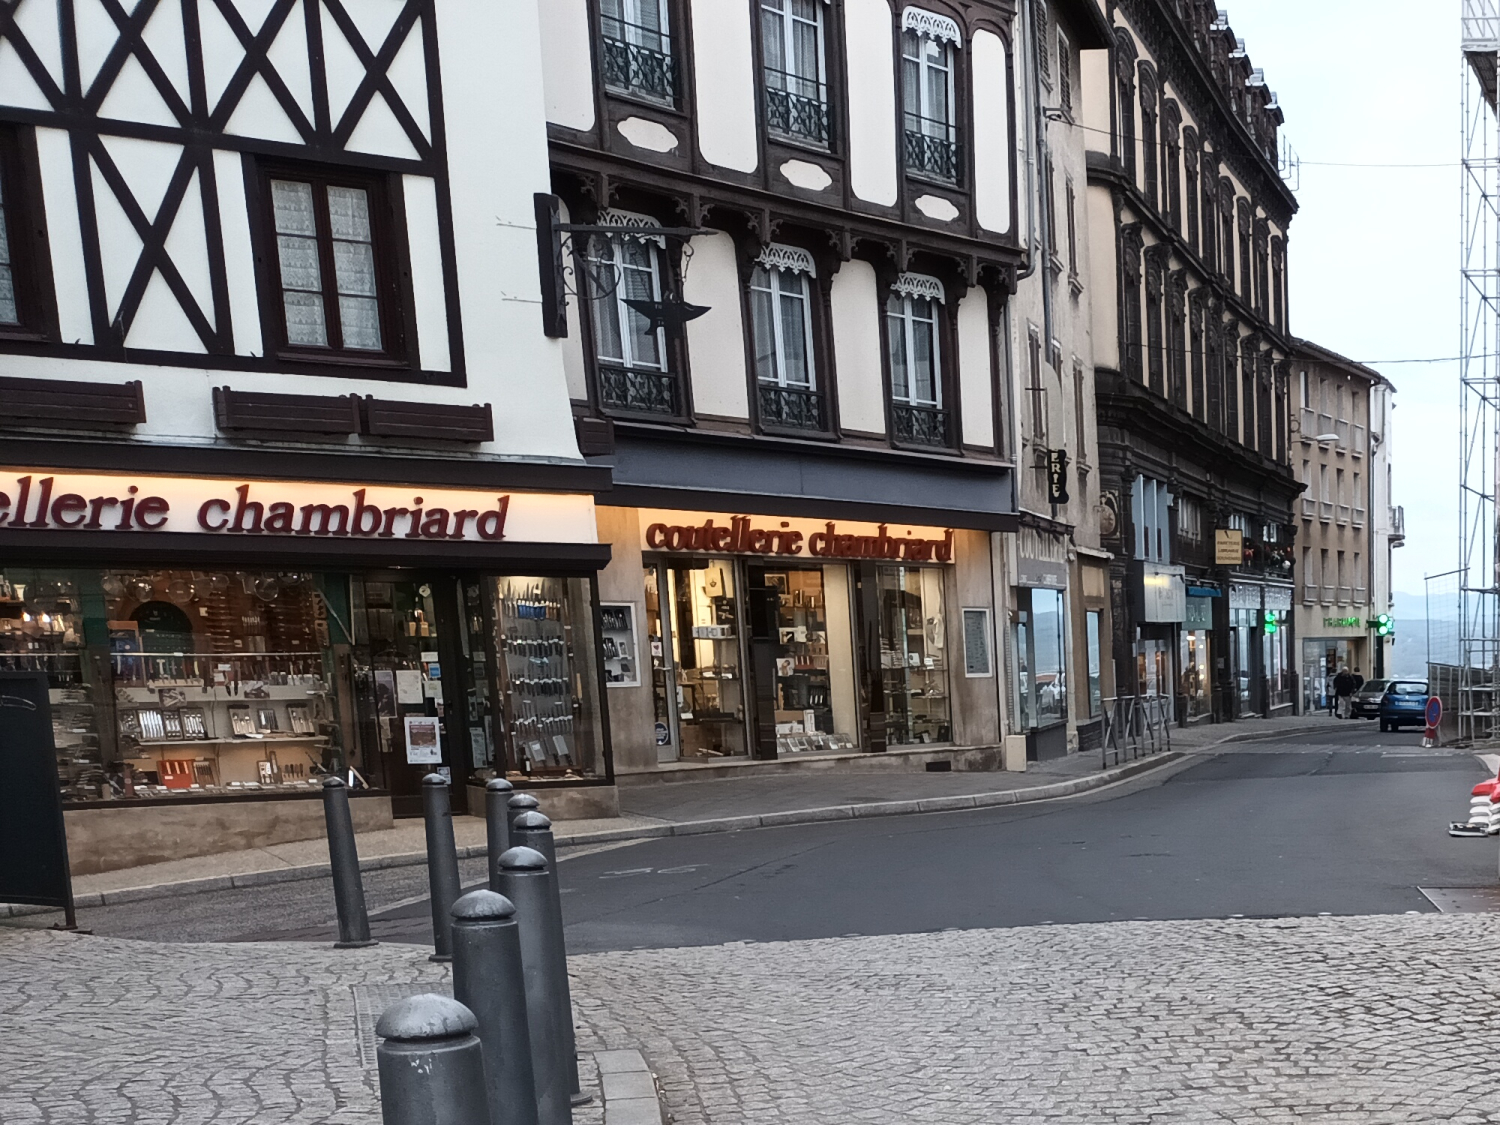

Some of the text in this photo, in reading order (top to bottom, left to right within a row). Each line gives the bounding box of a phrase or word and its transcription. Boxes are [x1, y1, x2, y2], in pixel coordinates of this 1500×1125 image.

[197, 483, 510, 540] chambriard
[646, 515, 954, 562] coutellerie chambriard
